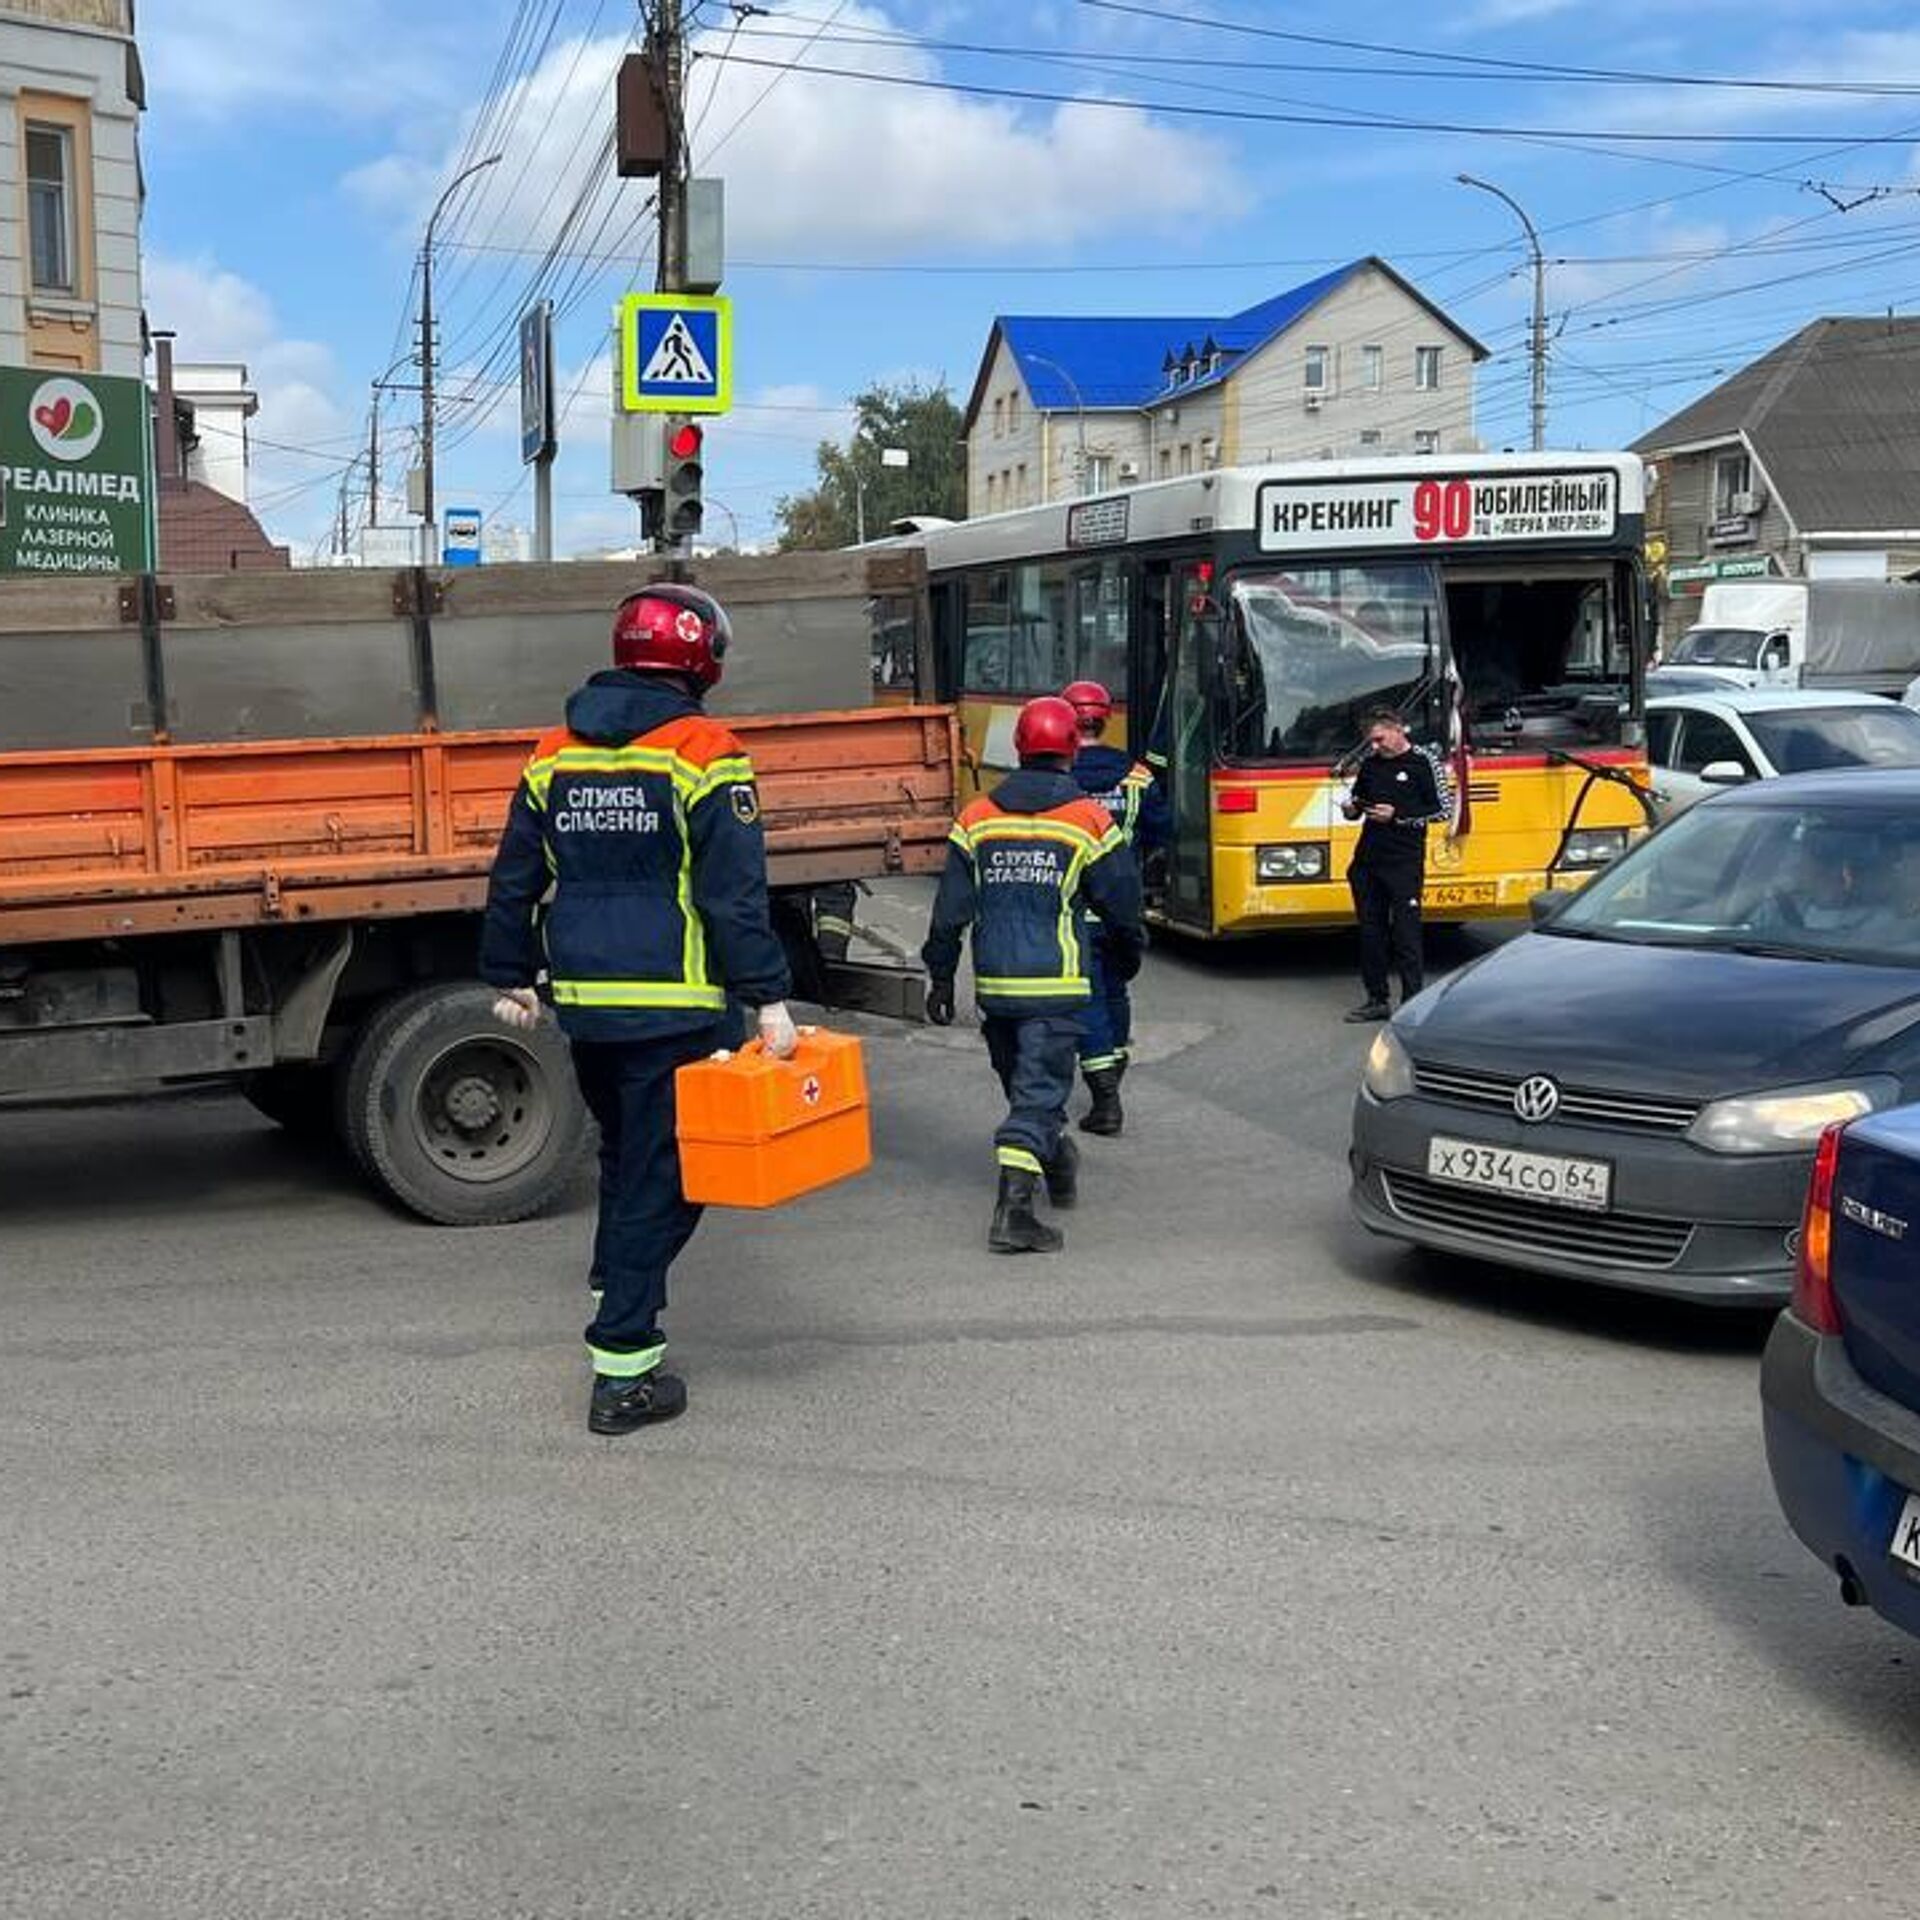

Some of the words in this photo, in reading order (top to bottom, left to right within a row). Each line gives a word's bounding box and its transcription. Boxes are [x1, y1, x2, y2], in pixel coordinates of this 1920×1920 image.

[24, 504, 110, 525] КЛИНИКА
[1273, 499, 1400, 533] КРЕКИНГ
[1413, 480, 1472, 541] 90
[1474, 475, 1609, 515] ЮБИЛЕЙНЫЙ
[21, 527, 114, 549] ЛАЗЕРНОЙ
[16, 550, 121, 571] МЕДИЦИНЫ
[567, 786, 646, 809] СЛУЖБА
